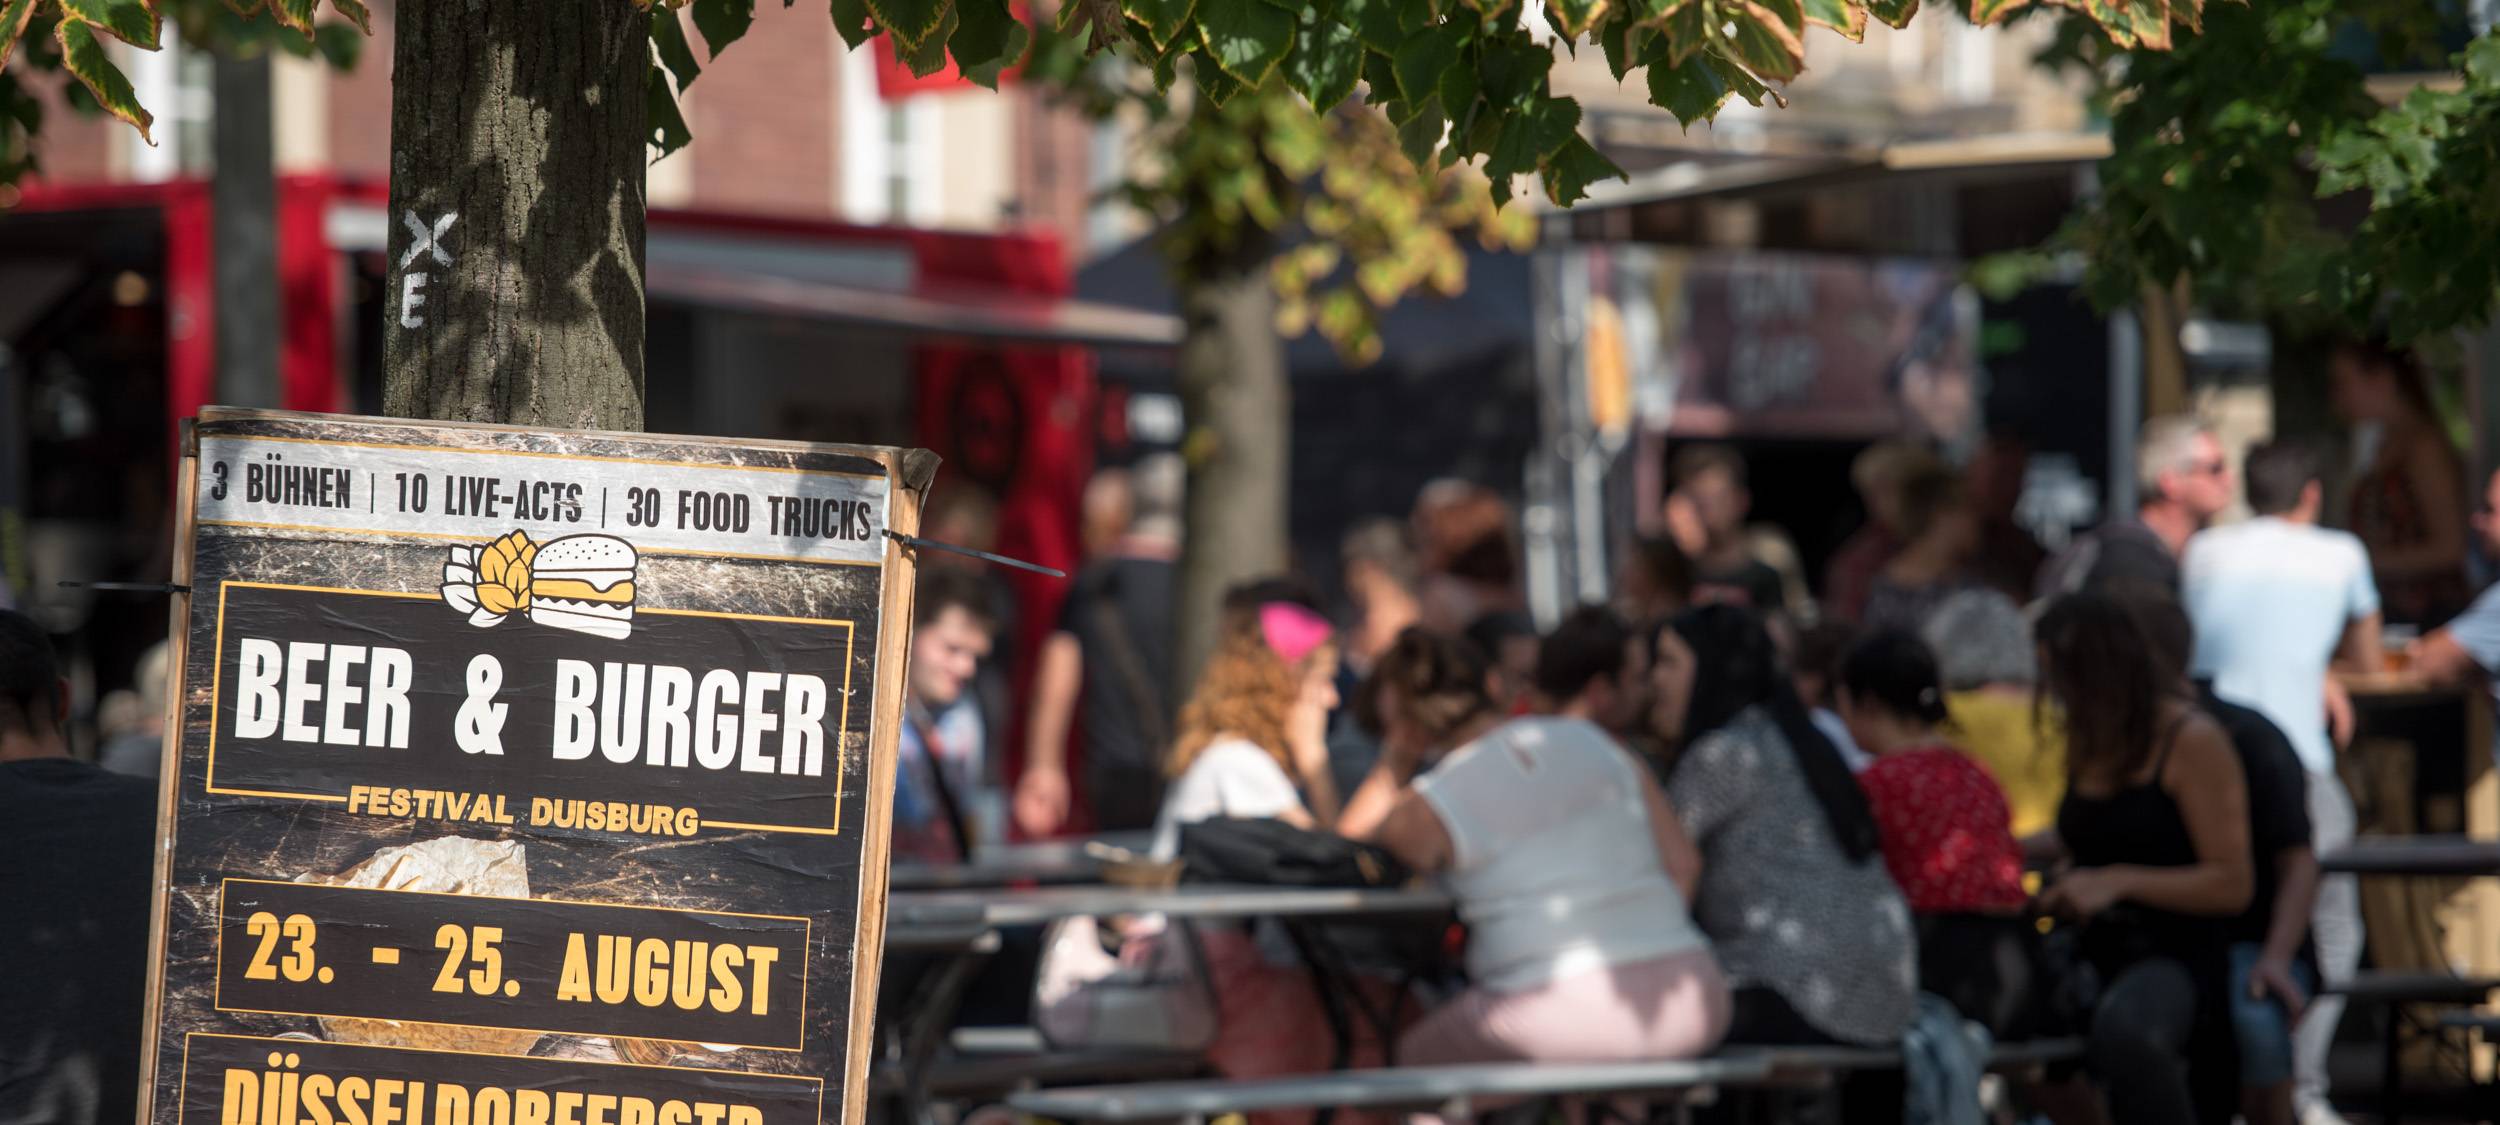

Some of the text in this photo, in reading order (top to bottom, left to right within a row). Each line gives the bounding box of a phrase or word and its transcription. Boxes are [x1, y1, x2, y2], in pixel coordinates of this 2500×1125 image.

[400, 272, 427, 328] E
[211, 452, 871, 541] 3 BÜHNEN 10 LIVE-ACTS 30 FOOD TRUCKS
[234, 637, 827, 777] BEER & BURGER
[347, 785, 699, 837] FESTIVAL DUISBURG
[244, 911, 334, 985] 23.
[432, 923, 520, 998] 25.
[556, 932, 779, 1016] AUGUST
[221, 1051, 764, 1125] DÜSSELDORF
